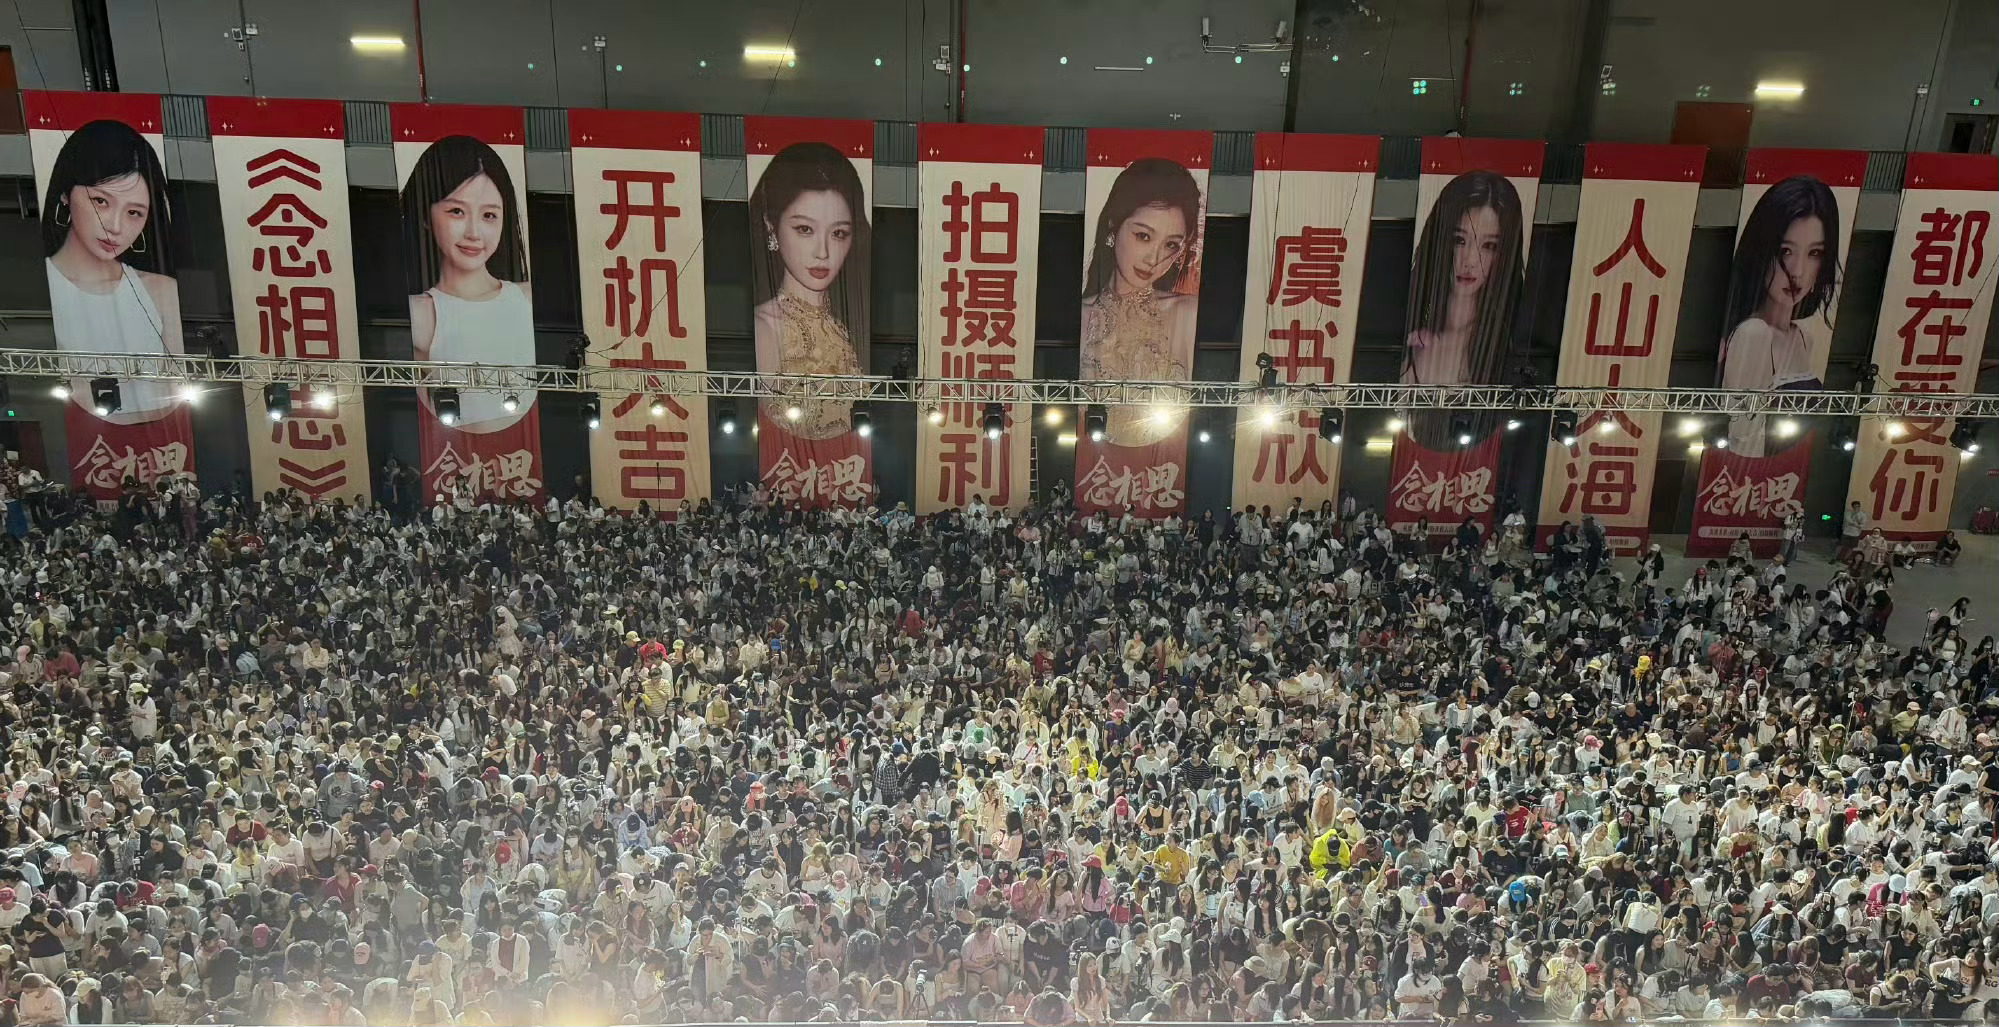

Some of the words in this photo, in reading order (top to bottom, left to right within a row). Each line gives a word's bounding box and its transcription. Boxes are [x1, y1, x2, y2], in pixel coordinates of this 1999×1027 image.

[600, 169, 690, 499] 开机大吉
[938, 181, 1018, 506] 拍摄顺利
[1559, 198, 1667, 514] 人山人海
[74, 434, 197, 489] 念相思
[424, 441, 542, 498] 念相思
[760, 448, 872, 501] 念相思
[1076, 455, 1184, 510] 念相思
[1390, 460, 1495, 515] 念相思
[1697, 465, 1802, 519] 念相思
